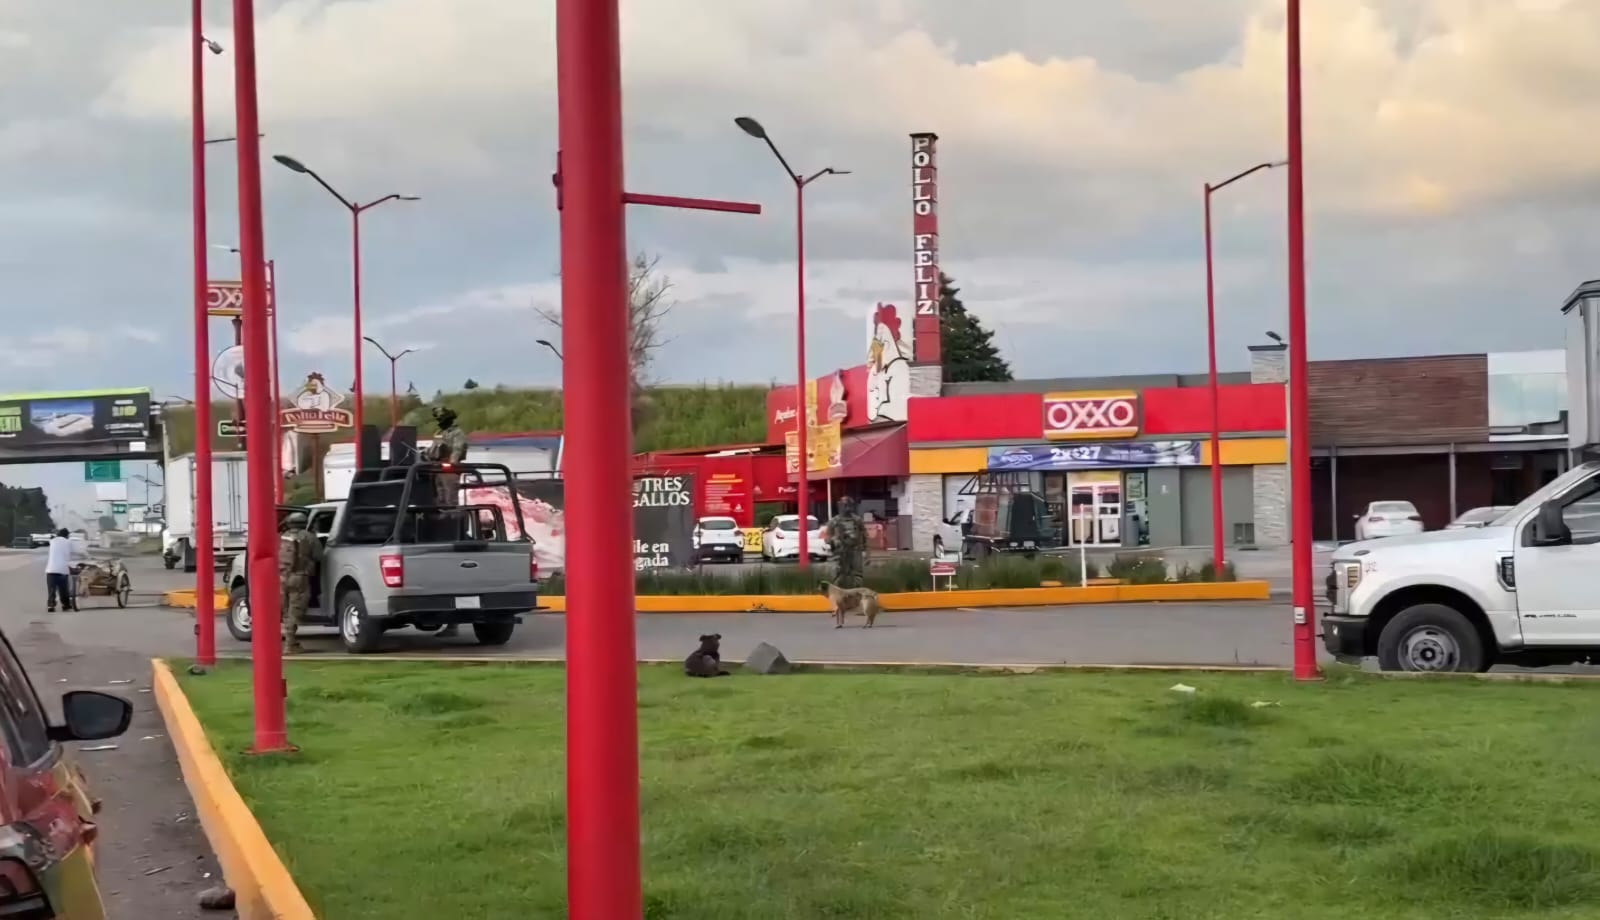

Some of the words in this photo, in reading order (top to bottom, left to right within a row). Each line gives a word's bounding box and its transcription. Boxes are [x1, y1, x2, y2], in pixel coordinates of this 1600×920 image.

[913, 137, 931, 216] POLLO
[915, 233, 934, 315] FELIZ
[1047, 400, 1134, 430] OXXO
[652, 542, 669, 553] en
